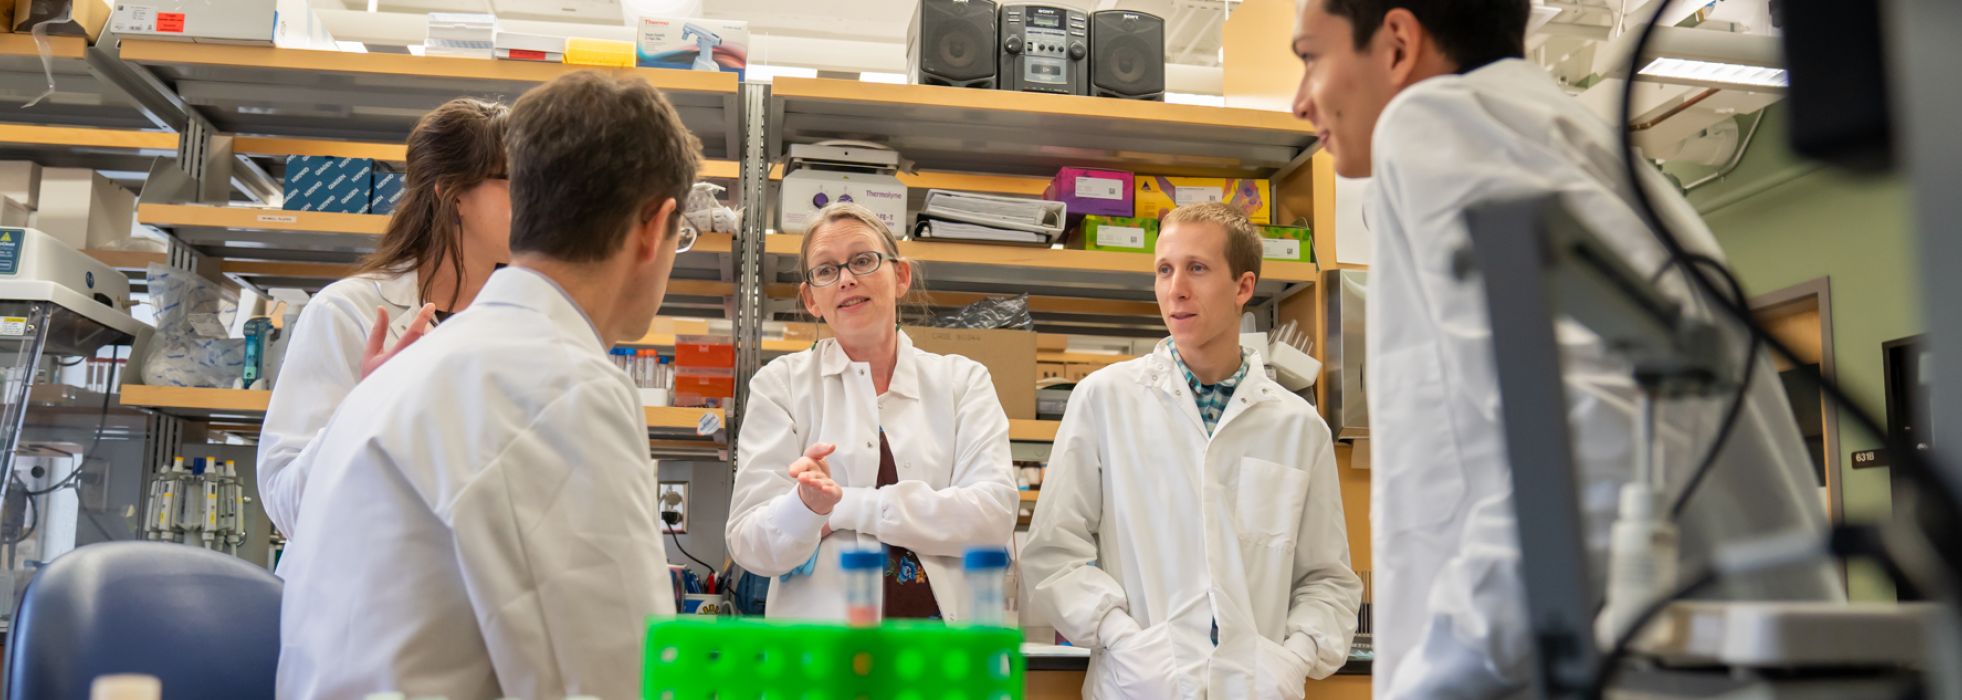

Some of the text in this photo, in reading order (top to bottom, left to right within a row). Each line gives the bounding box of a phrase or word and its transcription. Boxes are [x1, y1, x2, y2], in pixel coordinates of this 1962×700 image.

[290, 166, 310, 183] QIAGEN
[314, 160, 334, 176] QIAGEN
[351, 166, 370, 183] QIAGEN
[304, 181, 323, 197] QIAGEN
[328, 173, 347, 190] QIAGEN
[376, 173, 394, 189] QIAGEN
[340, 187, 360, 204] QIAGEN
[866, 189, 903, 200] Thermolyne
